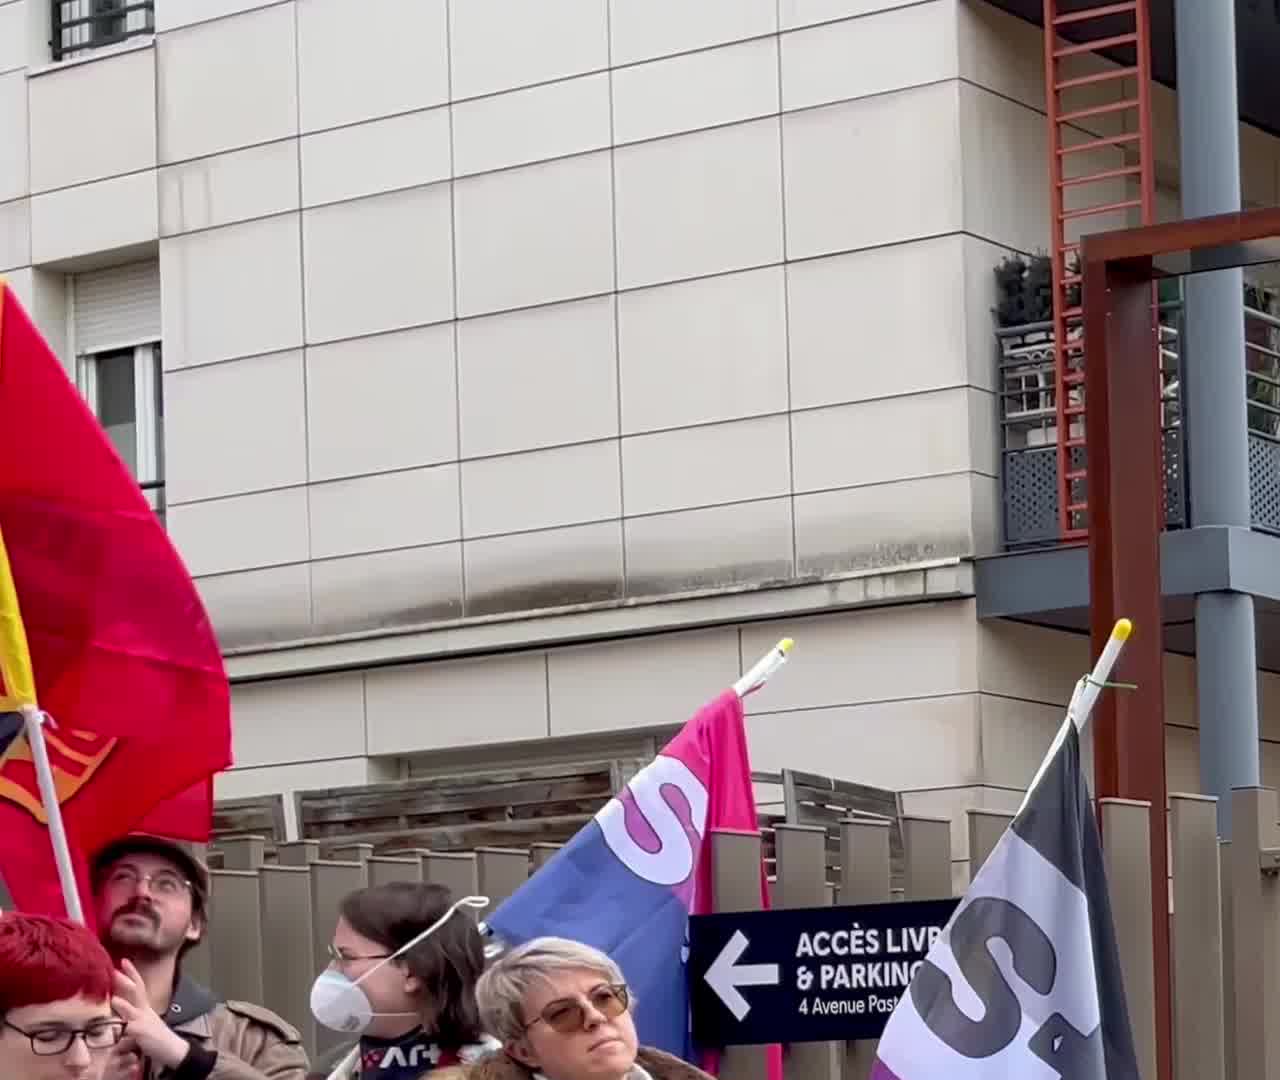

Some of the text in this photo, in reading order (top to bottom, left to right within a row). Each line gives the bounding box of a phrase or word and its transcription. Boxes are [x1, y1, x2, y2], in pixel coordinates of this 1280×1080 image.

[796, 922, 879, 957] ACCÈS
[796, 966, 814, 990] &
[798, 998, 808, 1015] 4
[812, 997, 865, 1015] Avenue
